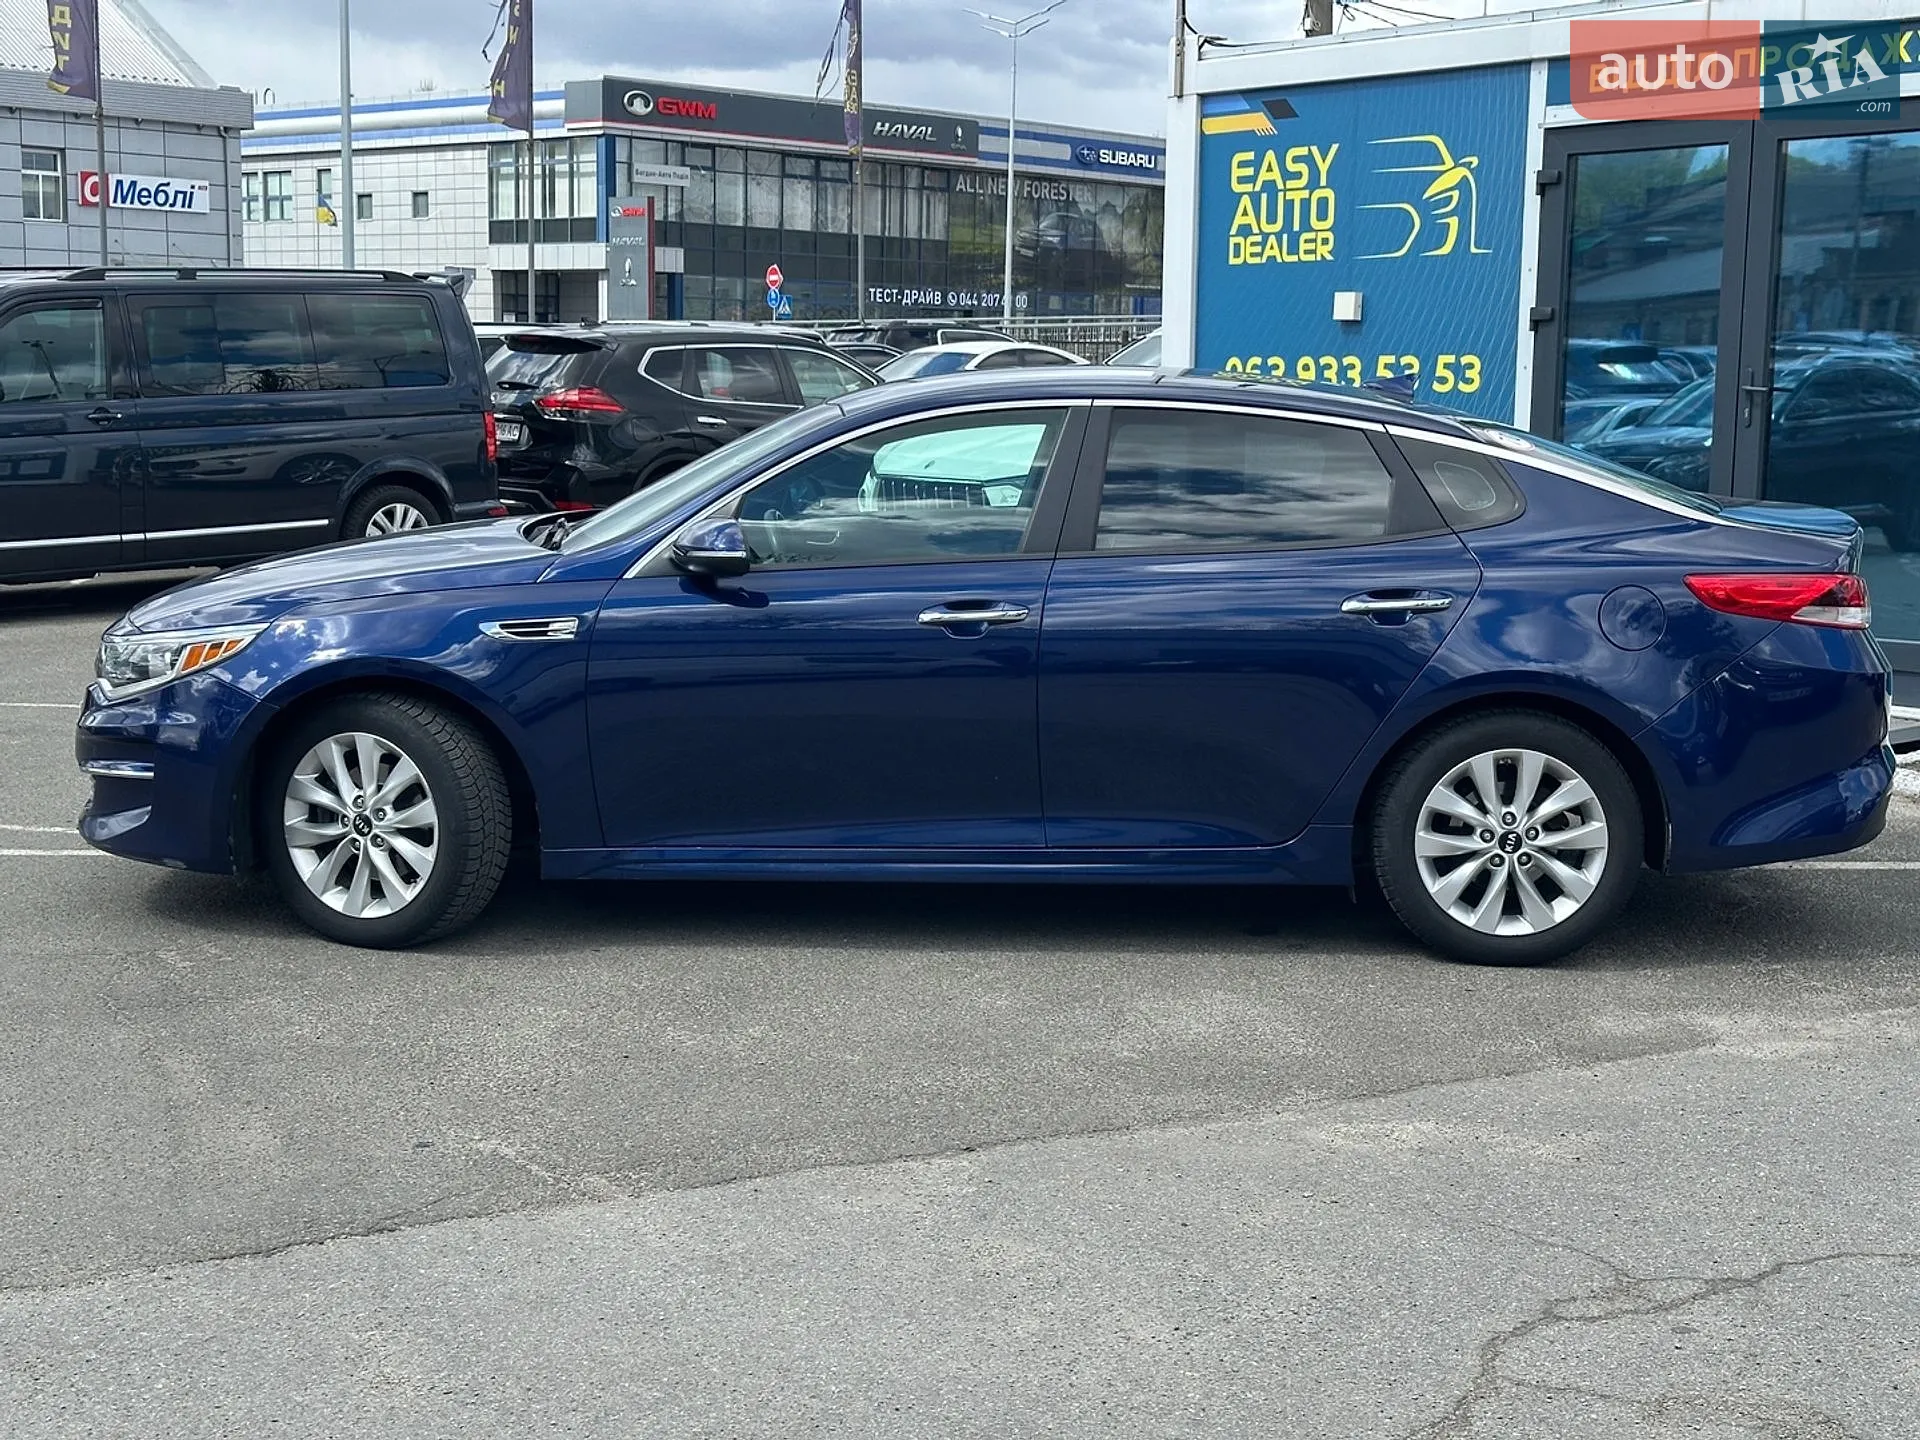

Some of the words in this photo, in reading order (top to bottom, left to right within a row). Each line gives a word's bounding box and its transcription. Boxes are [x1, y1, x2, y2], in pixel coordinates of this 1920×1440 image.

[1733, 29, 1920, 80] ПРОДАЖ
[657, 97, 717, 119] GWM
[873, 121, 937, 141] HAVAL
[1099, 149, 1156, 168] SUBARU
[1230, 143, 1340, 193] EASY
[112, 179, 195, 209] Меблі
[955, 173, 984, 193] ALL
[1229, 187, 1335, 235] AUTO
[1228, 231, 1335, 265] DEALER
[868, 288, 942, 306] ТЕСТ-ДРАЙВ
[959, 292, 978, 306] 044
[981, 293, 1000, 307] 207
[1431, 354, 1482, 393] 53
[1504, 833, 1518, 852] KIA
